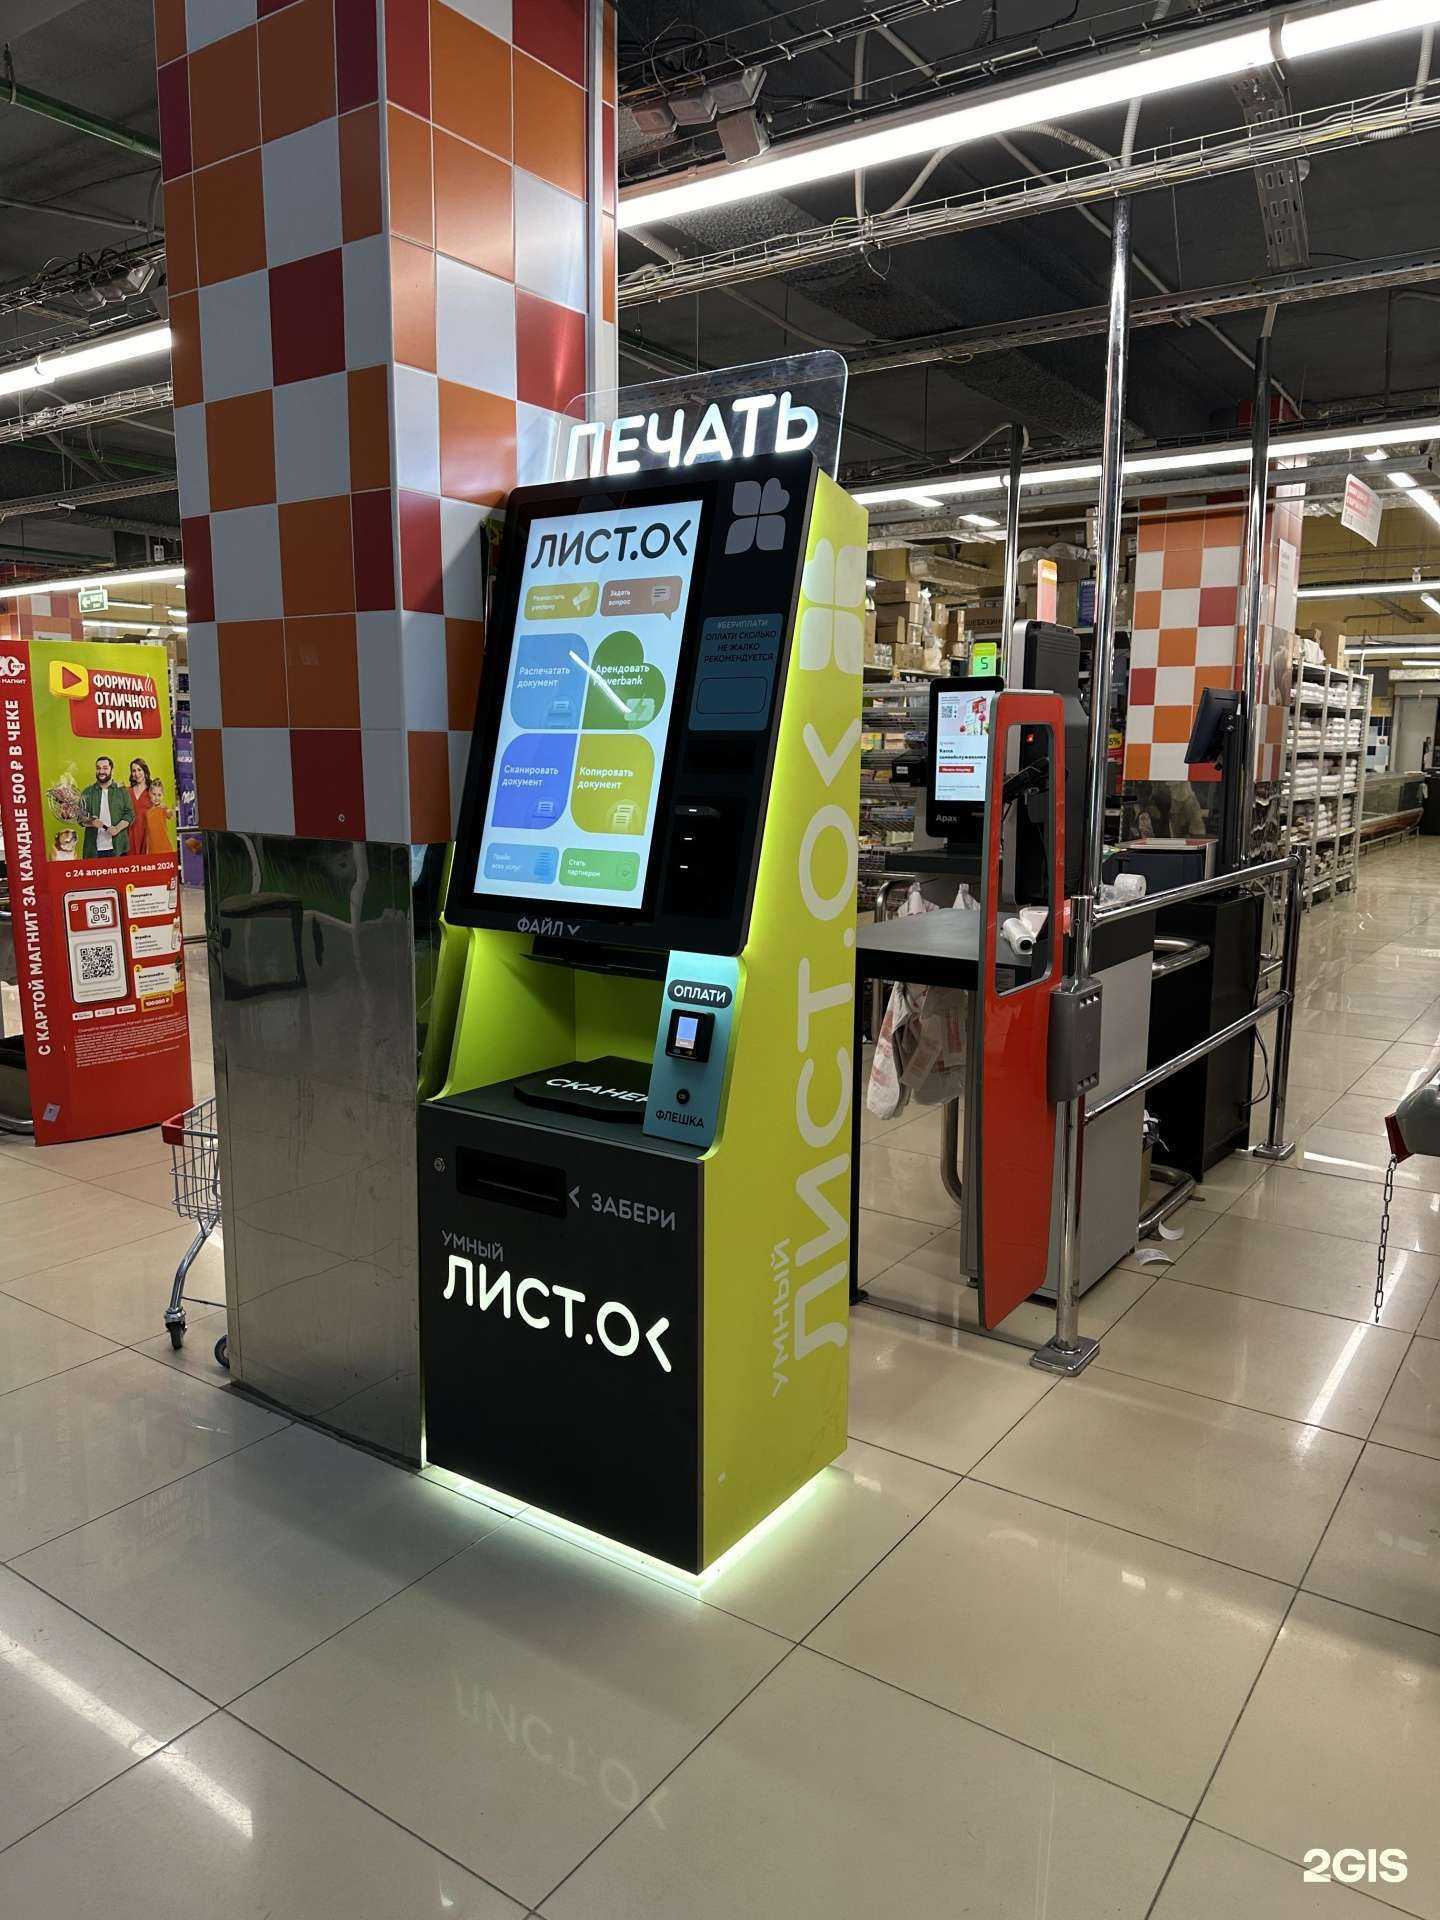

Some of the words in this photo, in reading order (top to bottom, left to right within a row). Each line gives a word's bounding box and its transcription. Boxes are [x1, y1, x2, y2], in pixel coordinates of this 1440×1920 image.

[565, 391, 819, 480] ПЕЧАТЬ
[705, 632, 738, 640] ОПЛАТИ
[738, 630, 777, 640] СКОЛЬКО
[718, 643, 729, 652] НЕ
[730, 642, 760, 651] ЖАЛКО
[704, 653, 774, 662] РЕКОМЕНДУЕТСЯ
[980, 656, 988, 670] 5
[519, 666, 570, 676] Распечатать
[595, 664, 650, 675] Арендовать
[93, 674, 143, 692] ФОРМУЛА
[517, 679, 558, 688] документ
[95, 692, 156, 708] ОТЛИЧНОГО
[6, 700, 20, 743] ЧЕКЕ
[97, 708, 143, 730] ГРИЛЯ
[9, 745, 22, 756] В
[504, 765, 559, 776] Сканировать
[579, 766, 634, 778] Копировать
[502, 778, 543, 788] документ
[578, 779, 622, 790] документ
[15, 809, 34, 881] КАЖДЫЕ
[74, 869, 84, 877] 24
[86, 868, 118, 878] апреля
[141, 864, 156, 872] мая
[157, 862, 175, 871] 2024
[568, 858, 586, 866] Стать
[23, 885, 36, 906] ЗА
[517, 916, 564, 936] ФАЙЛ
[24, 911, 43, 976] МАГНИТ
[674, 984, 726, 1003] ОПЛАТИ
[28, 980, 50, 1041] КАРТОЙ
[38, 1046, 50, 1056] С
[656, 1110, 704, 1128] ФЛЕШКА
[592, 1193, 676, 1231] ЗАБЕРИ
[442, 1230, 504, 1262] УМНЫЙ
[771, 1238, 791, 1398] УМНЫЙ
